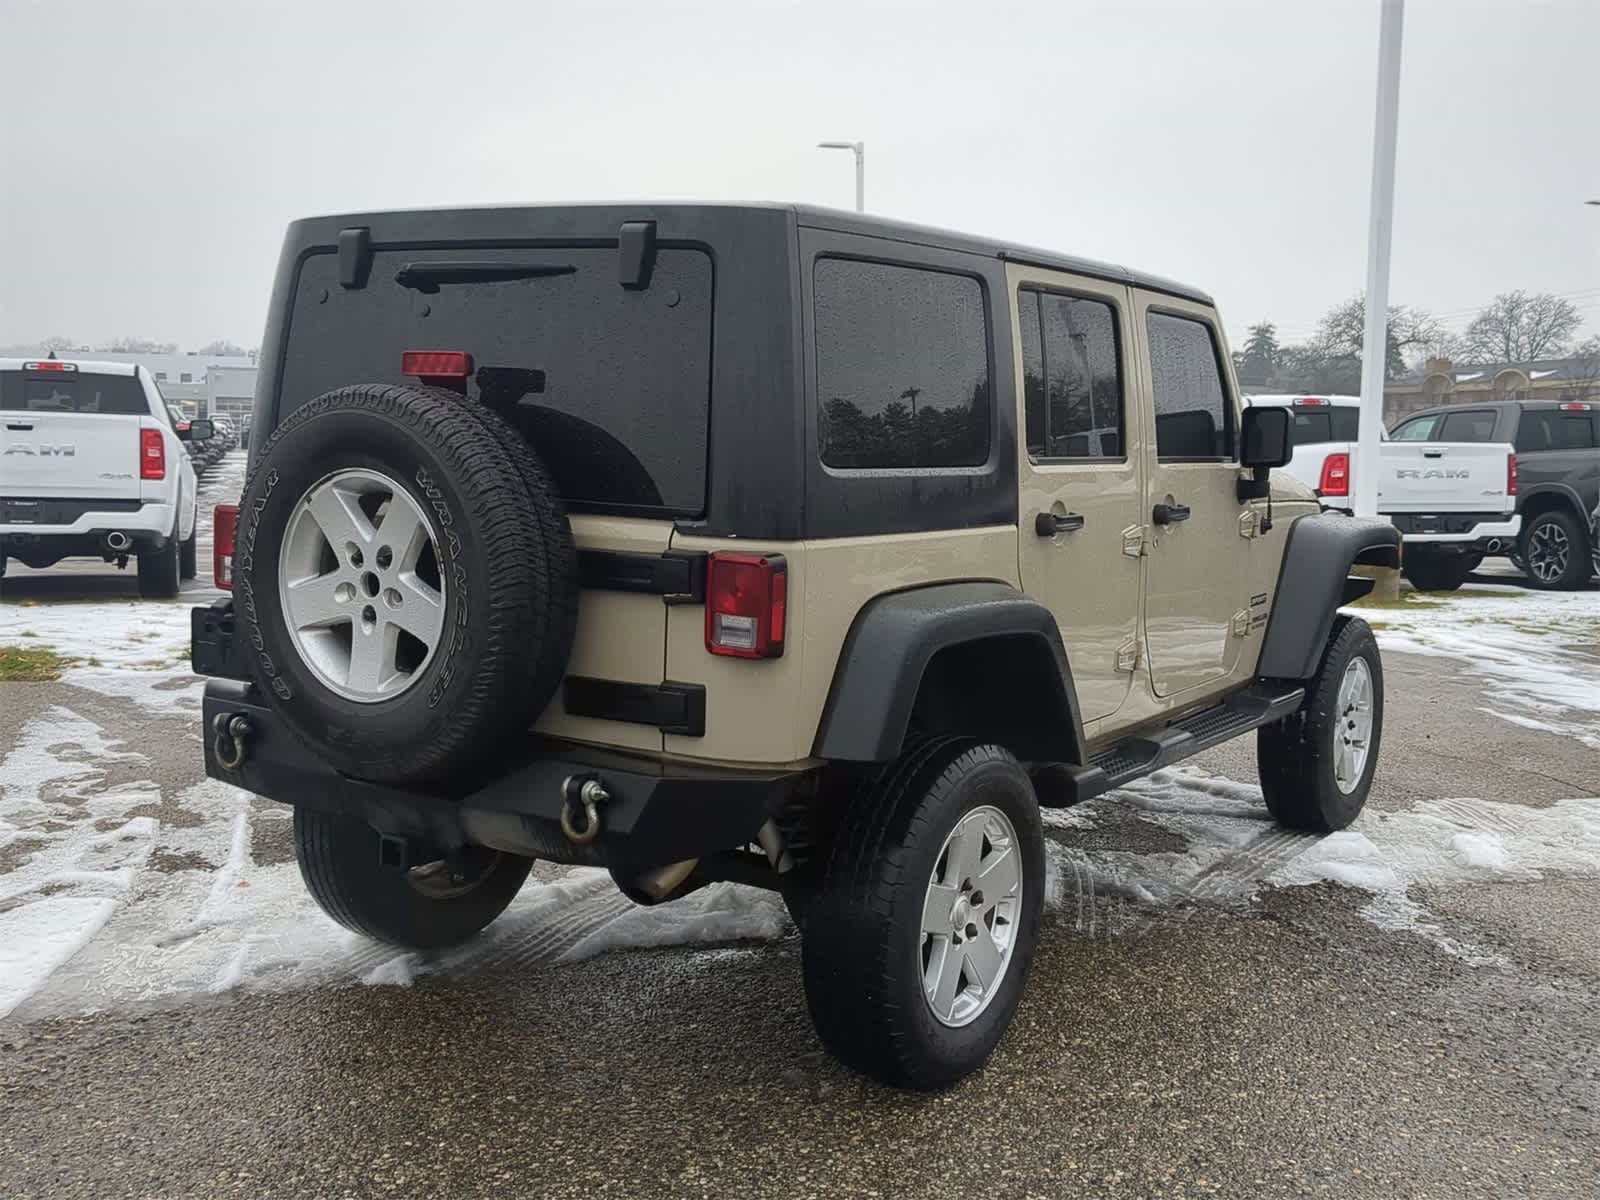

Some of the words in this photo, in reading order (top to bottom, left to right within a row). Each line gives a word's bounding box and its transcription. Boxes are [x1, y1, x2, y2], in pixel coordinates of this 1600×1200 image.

[241, 468, 292, 700] GOODYEAR
[415, 469, 468, 708] WRANGLER
[1396, 469, 1470, 479] RAM
